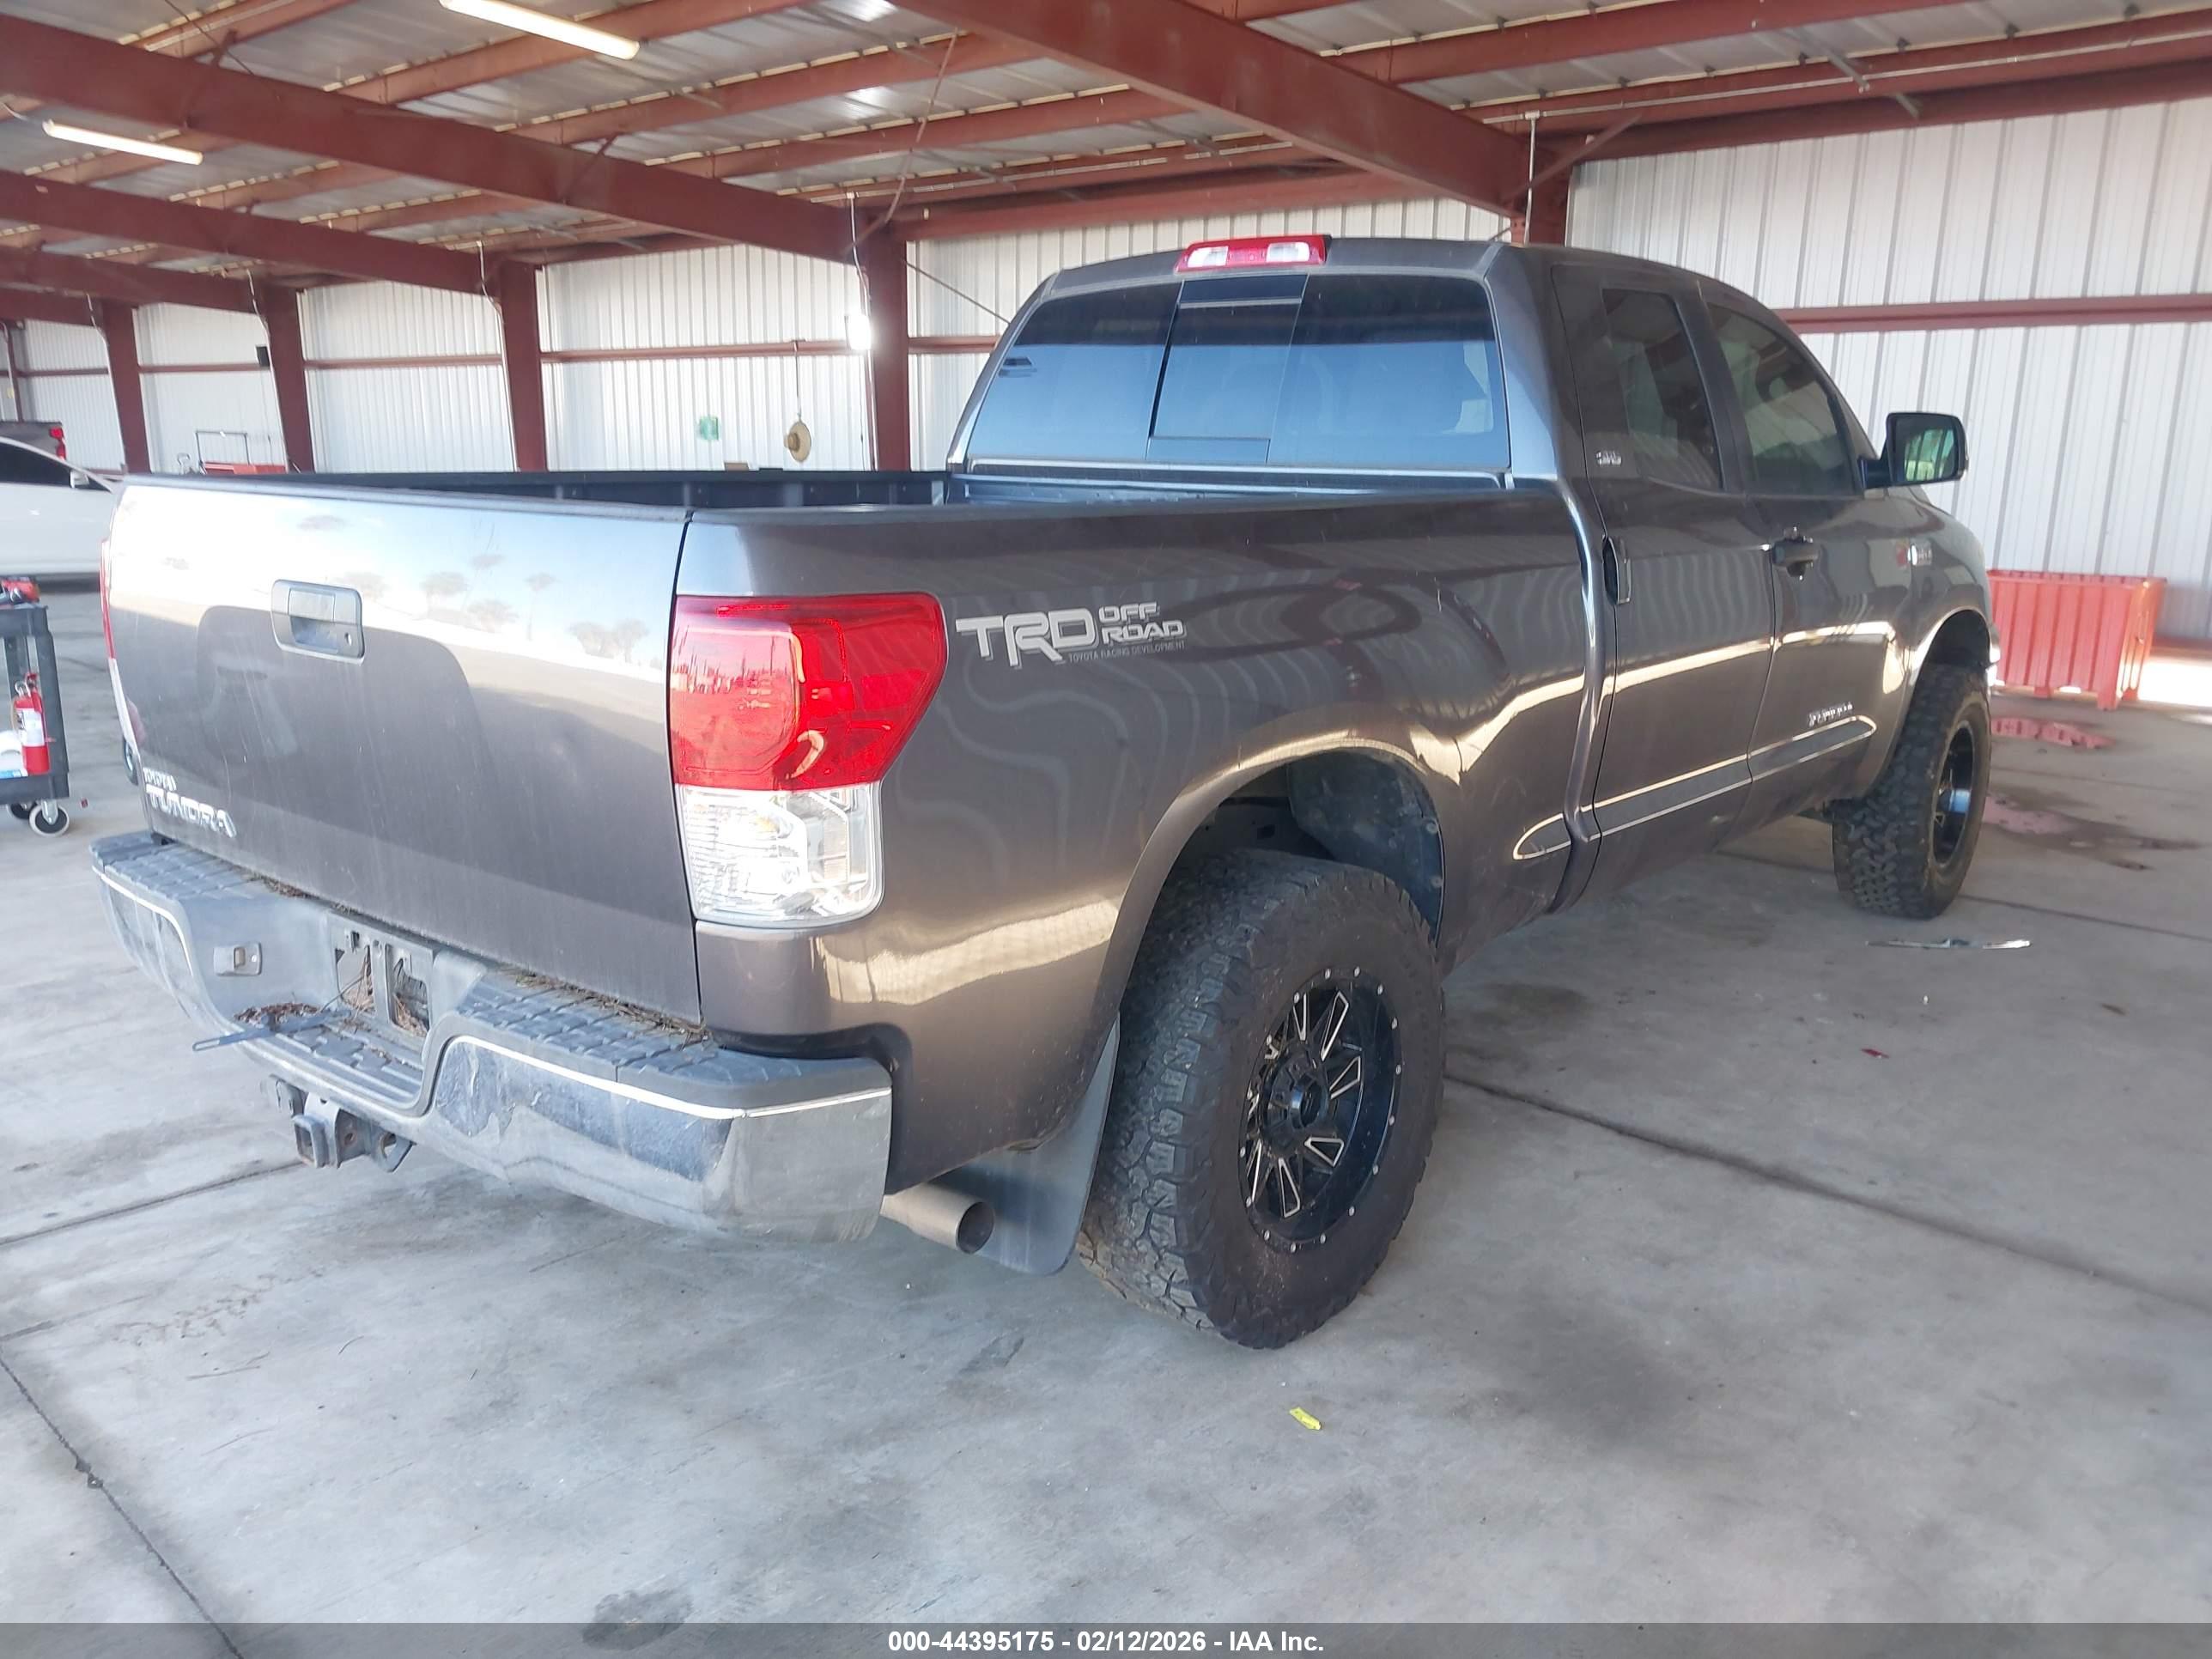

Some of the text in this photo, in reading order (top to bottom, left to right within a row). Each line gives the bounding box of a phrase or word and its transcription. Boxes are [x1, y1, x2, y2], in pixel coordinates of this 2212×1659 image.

[955, 602, 1158, 667] TRD OFF
[1069, 640, 1186, 663] TOYOTA RACING DEVELOPMENT
[1102, 620, 1185, 644] ROAD
[145, 783, 237, 838] TUNDRA
